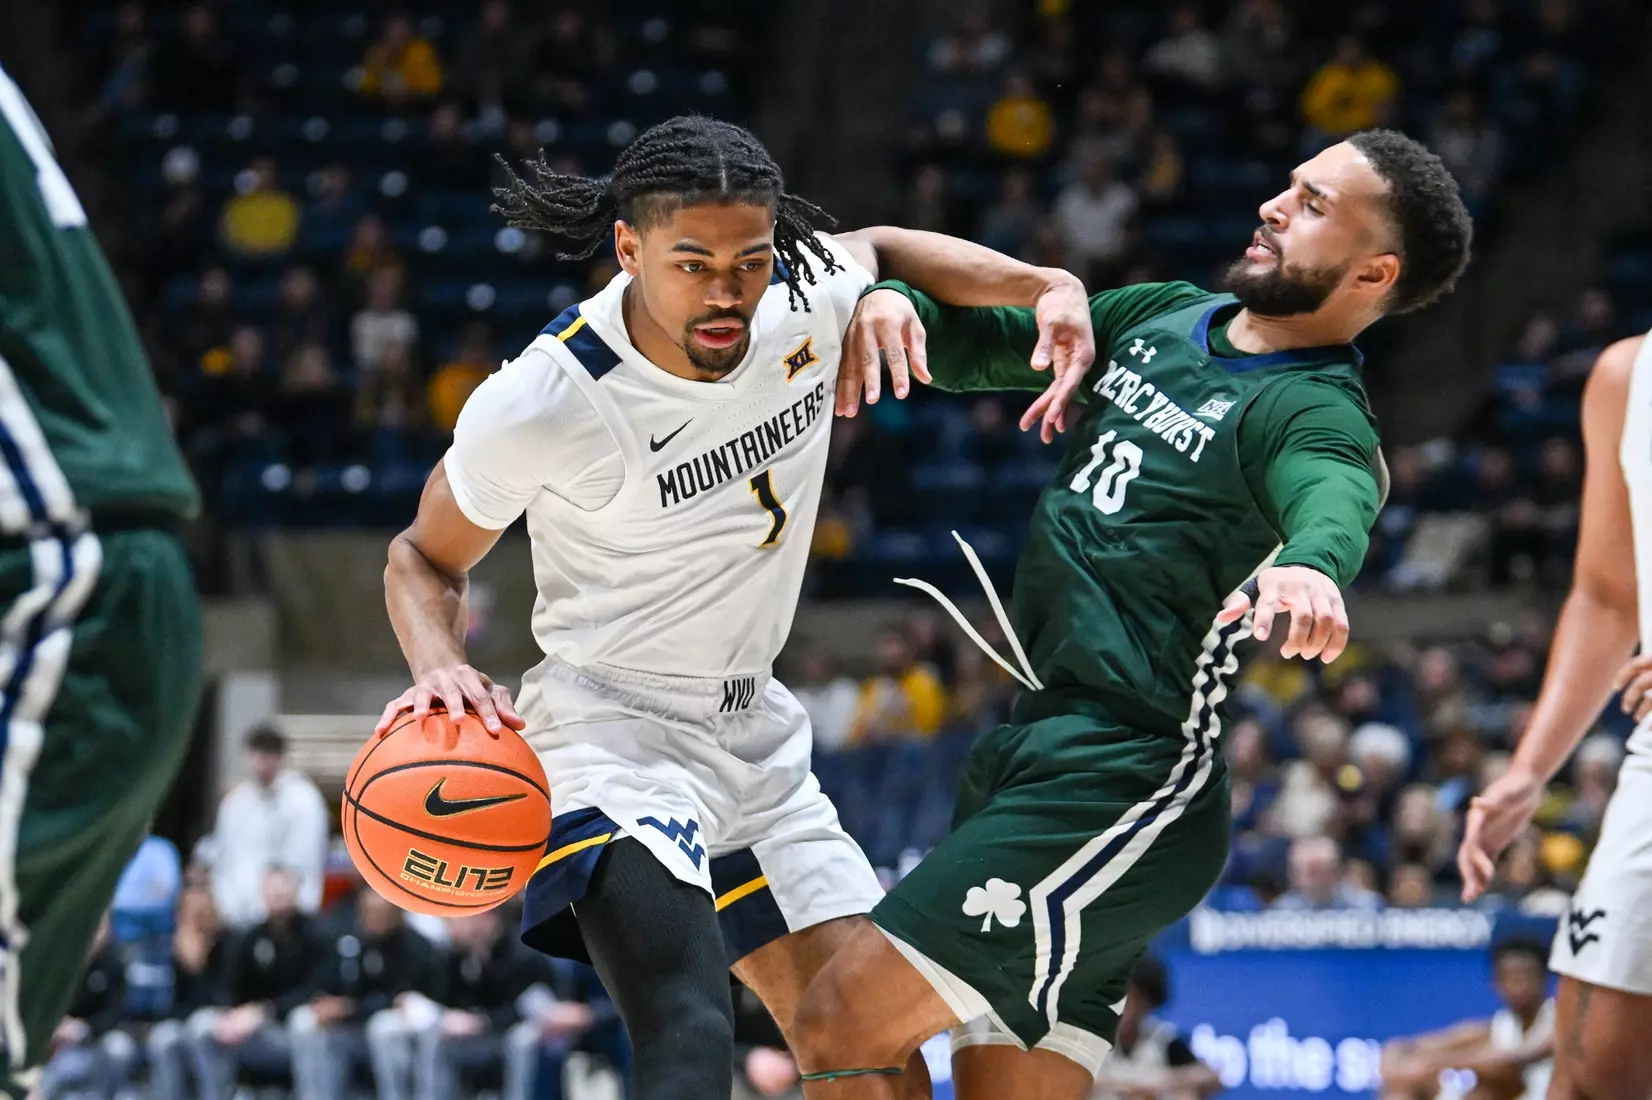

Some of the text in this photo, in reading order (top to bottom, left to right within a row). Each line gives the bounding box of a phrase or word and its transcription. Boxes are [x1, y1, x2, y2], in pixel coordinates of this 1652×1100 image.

[656, 381, 824, 508] MOUNTAINEERS
[1093, 360, 1216, 463] MERCYHURST
[749, 466, 789, 548] 1
[1069, 429, 1144, 515] 10
[719, 676, 755, 713] WVU
[400, 872, 505, 897] CHAMPIONSHIP
[403, 847, 515, 891] ELITE
[1248, 1017, 1333, 1092] the
